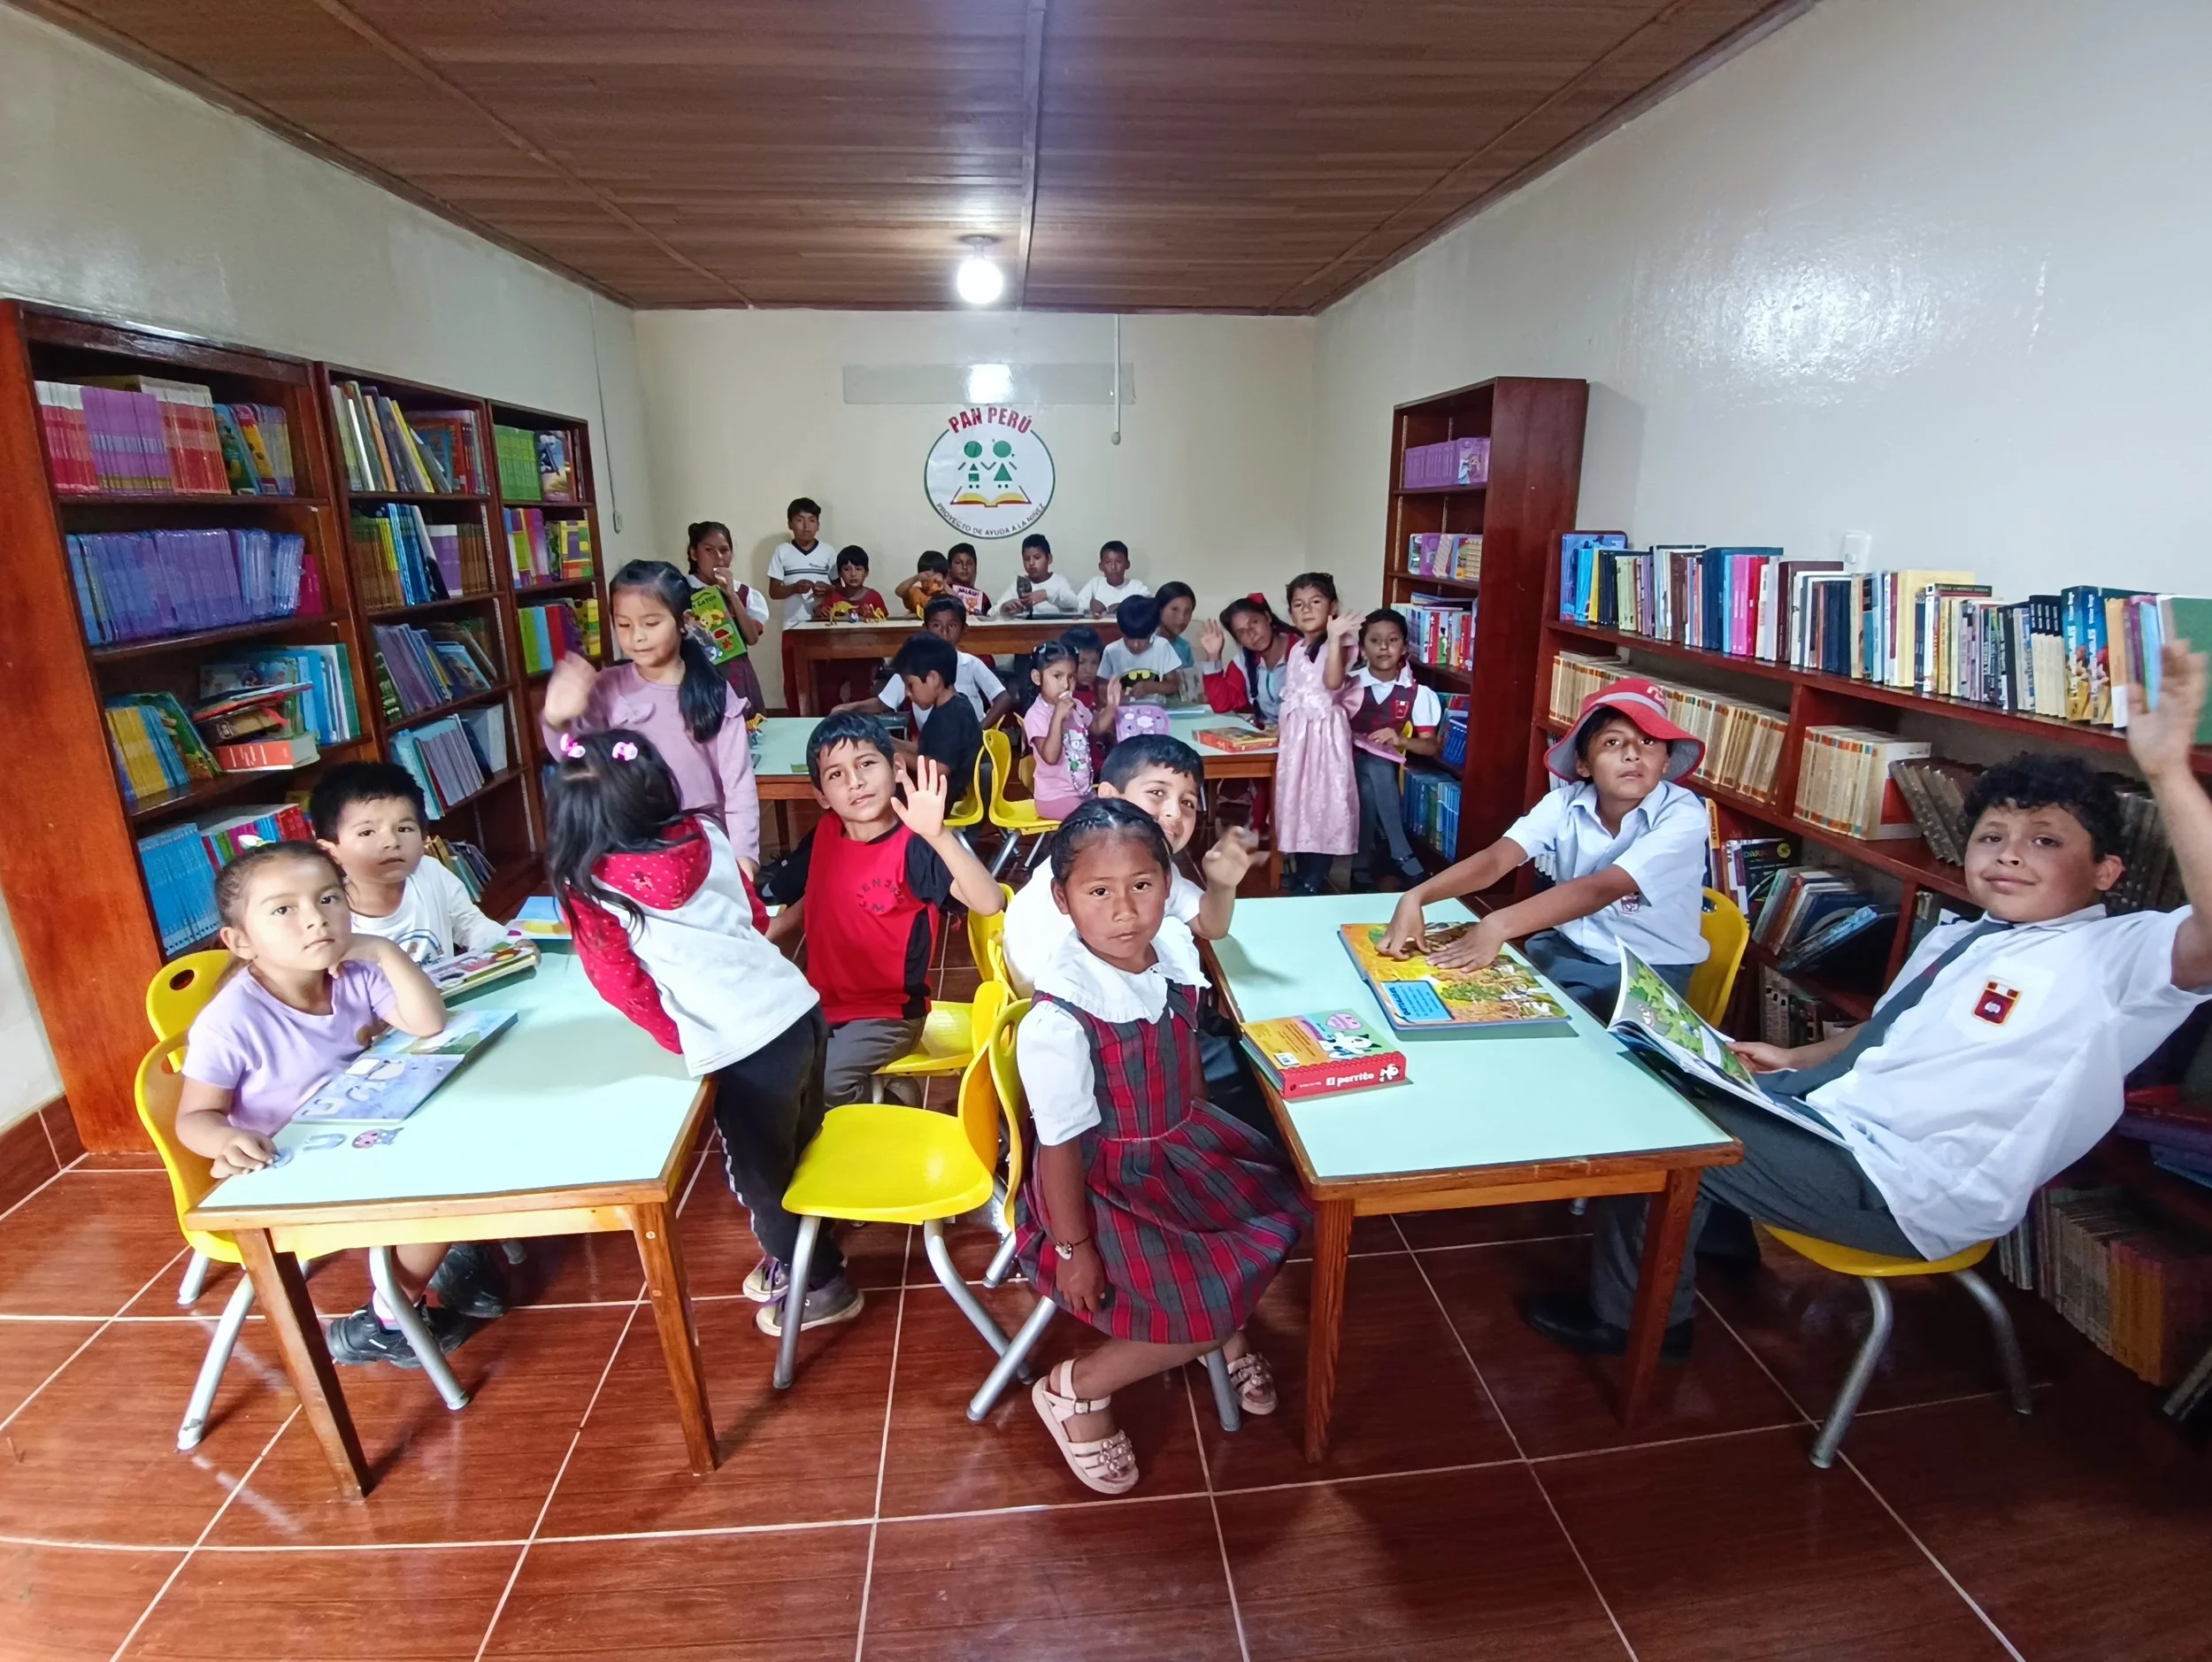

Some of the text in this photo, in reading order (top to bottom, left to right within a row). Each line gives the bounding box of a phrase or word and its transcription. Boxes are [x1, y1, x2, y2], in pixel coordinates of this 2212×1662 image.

[949, 406, 1033, 434] PAN PERÚ
[936, 503, 972, 532] PROYECTO
[985, 527, 1010, 536] AYUDA
[1018, 520, 1028, 529] LA
[1325, 1077, 1336, 1086] El
[1337, 1072, 1374, 1087] perrito
